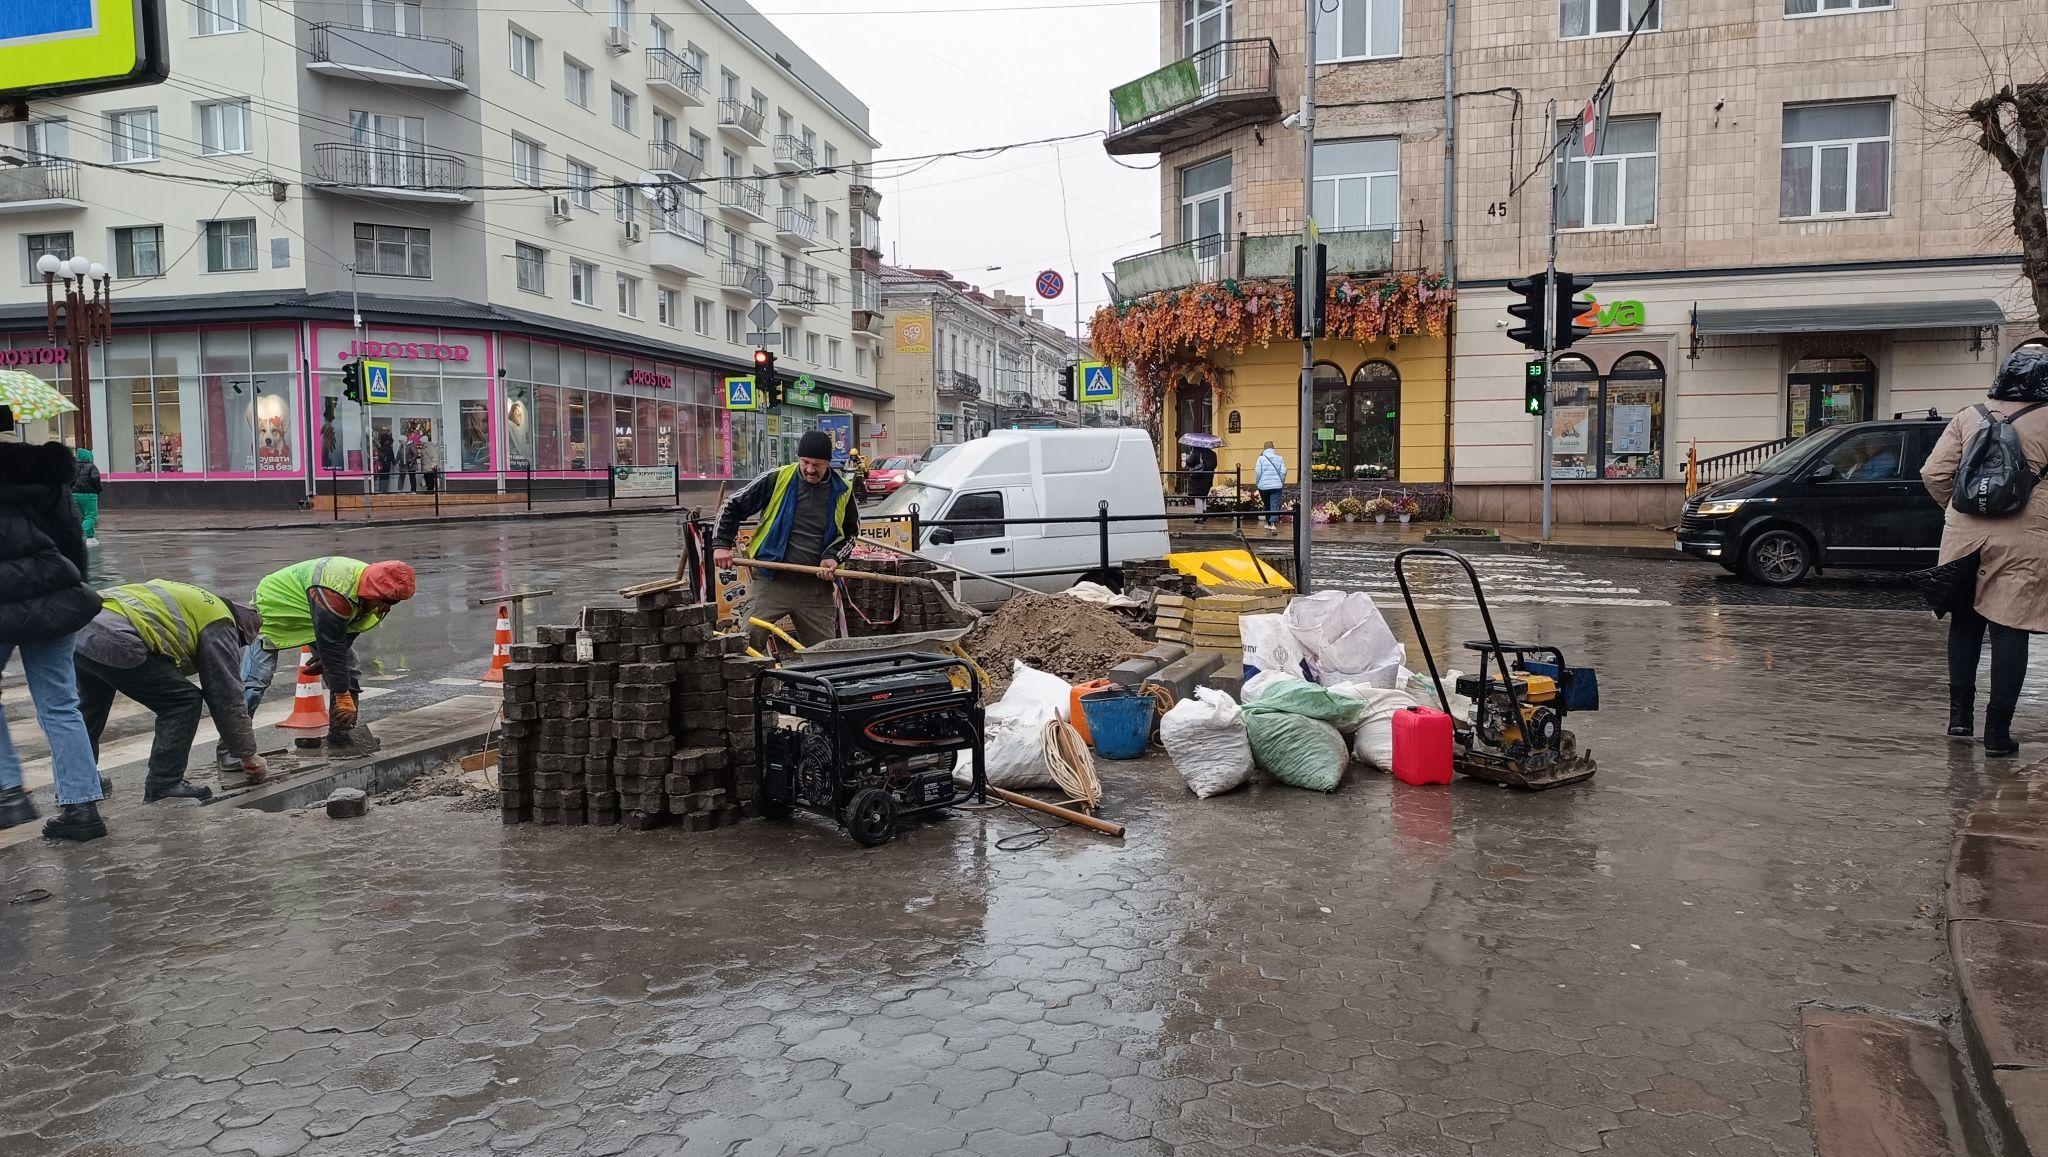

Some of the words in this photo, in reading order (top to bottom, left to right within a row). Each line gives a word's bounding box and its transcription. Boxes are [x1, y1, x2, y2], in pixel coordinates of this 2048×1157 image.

[1487, 201, 1507, 217] 45
[1529, 365, 1541, 376] 33
[633, 369, 673, 388] PROSTOR
[275, 462, 293, 471] без
[1979, 476, 1990, 494] LOVE
[1978, 498, 1987, 513] OVE
